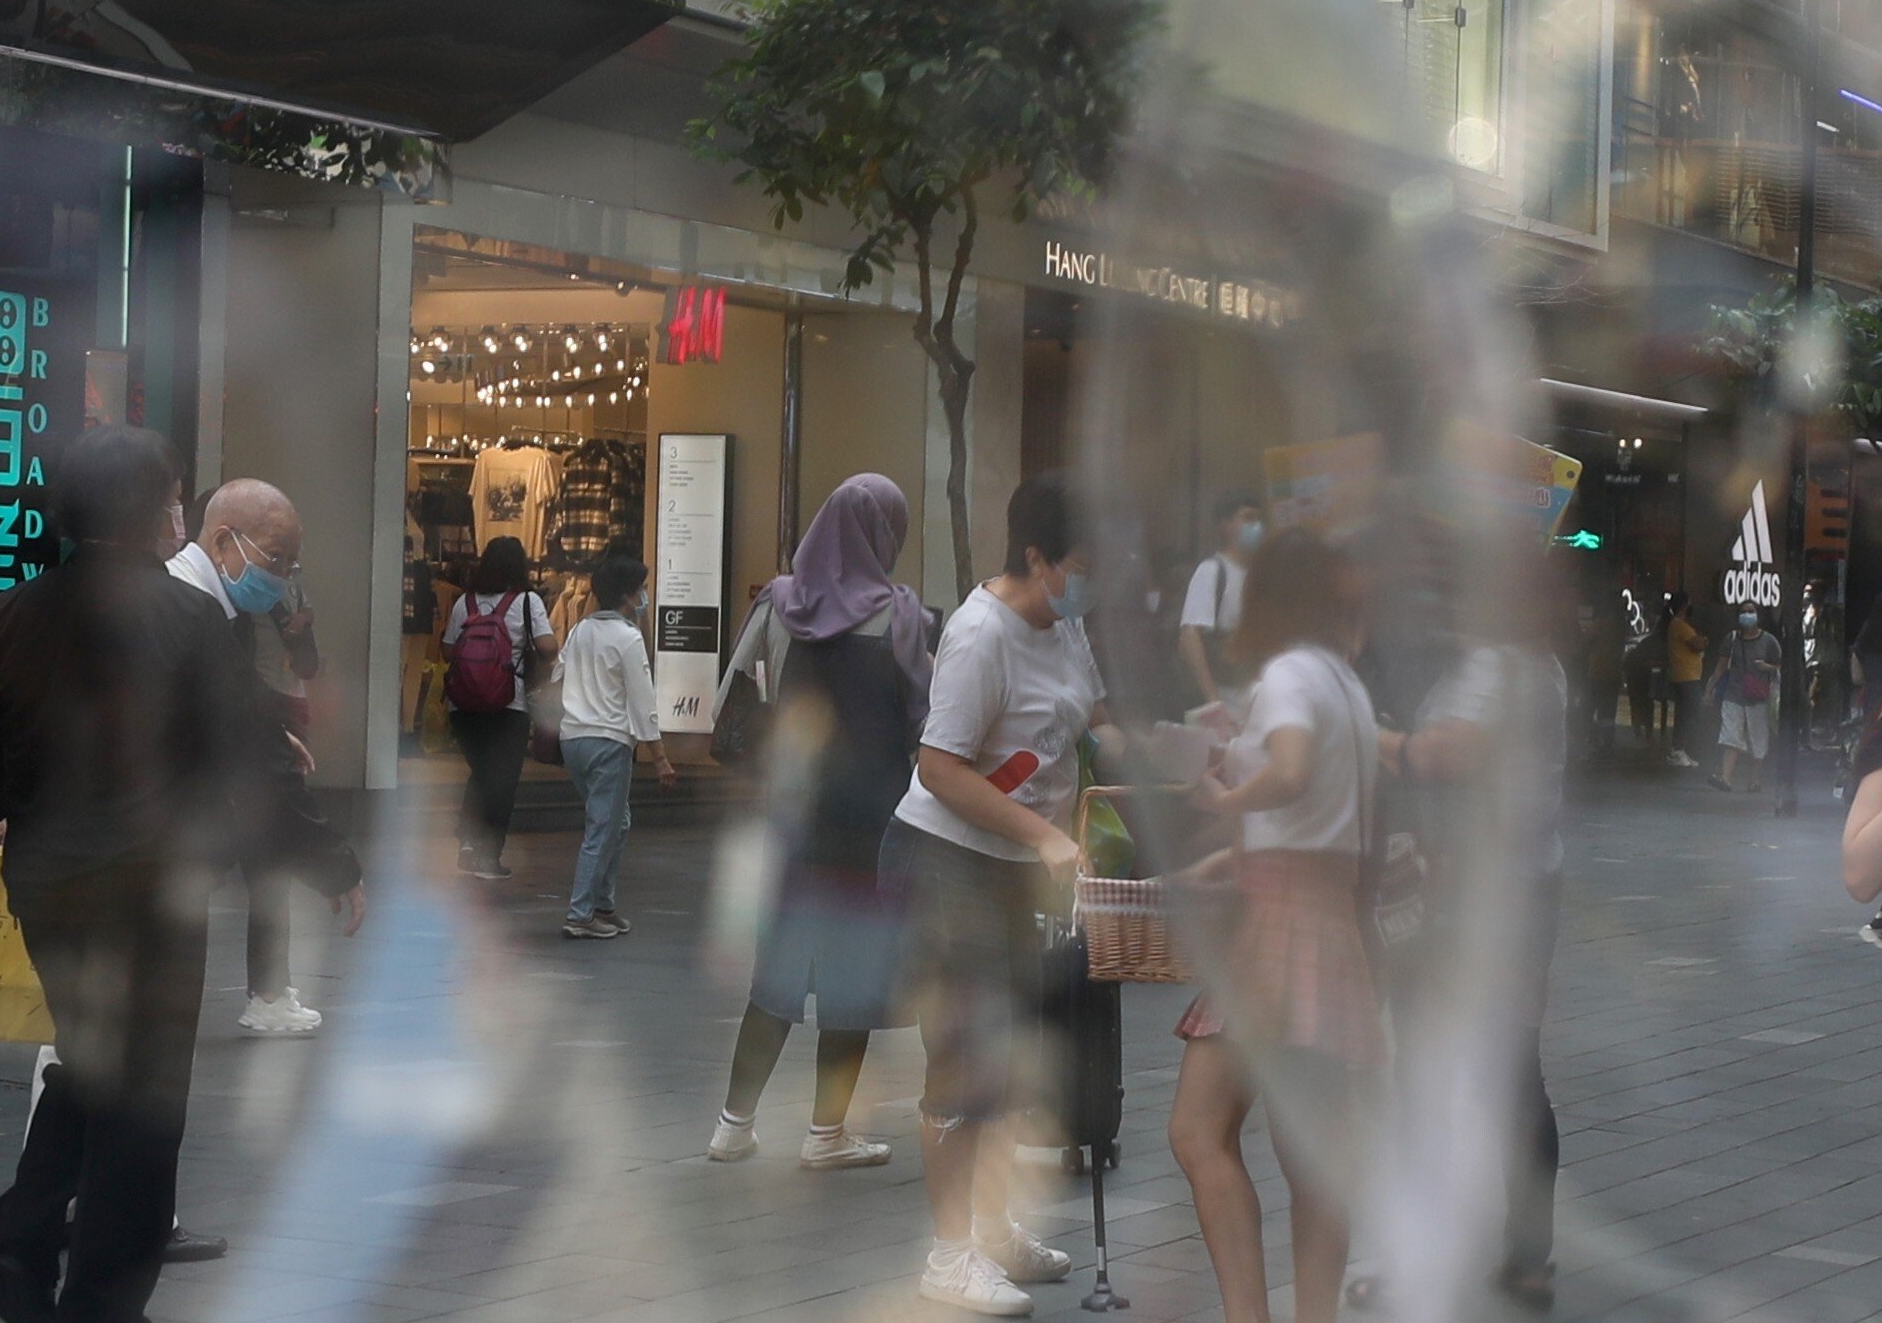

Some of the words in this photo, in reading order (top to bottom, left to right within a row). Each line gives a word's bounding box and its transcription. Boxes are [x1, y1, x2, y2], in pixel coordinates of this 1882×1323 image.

[1045, 241, 1095, 284] HANG
[1724, 560, 1781, 607] adidas
[665, 610, 684, 625] GF
